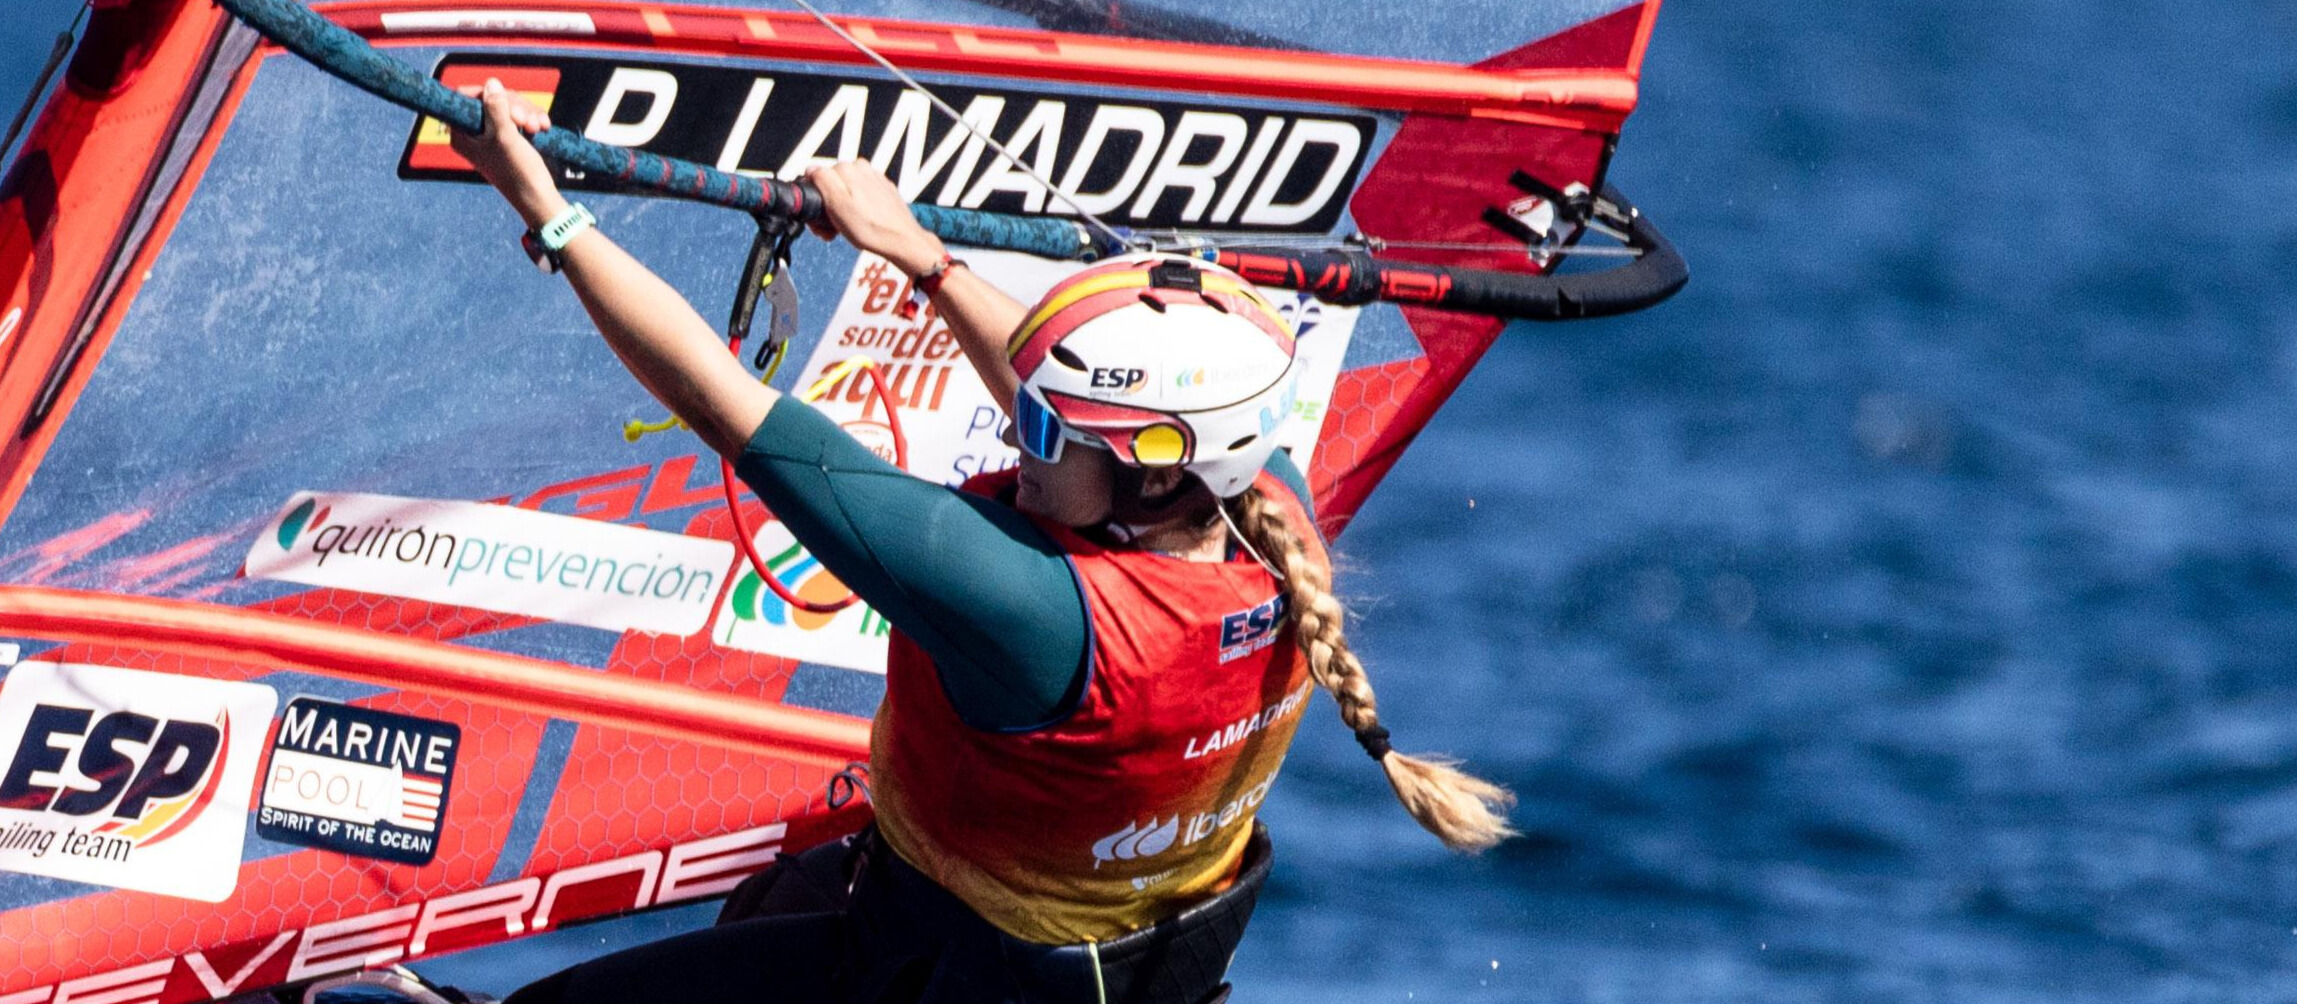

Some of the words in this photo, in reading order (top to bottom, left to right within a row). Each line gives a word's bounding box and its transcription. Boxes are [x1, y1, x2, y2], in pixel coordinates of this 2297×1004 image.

[714, 77, 1362, 227] LAMADRID
[1090, 367, 1145, 389] ESP
[0, 703, 221, 820] ESP
[278, 706, 453, 775] MARINE
[271, 765, 369, 811] POOL
[61, 826, 132, 862] team
[260, 807, 316, 832] SPIRIT
[318, 820, 340, 837] OF
[345, 825, 376, 844] THE
[380, 830, 432, 853] OCEAN
